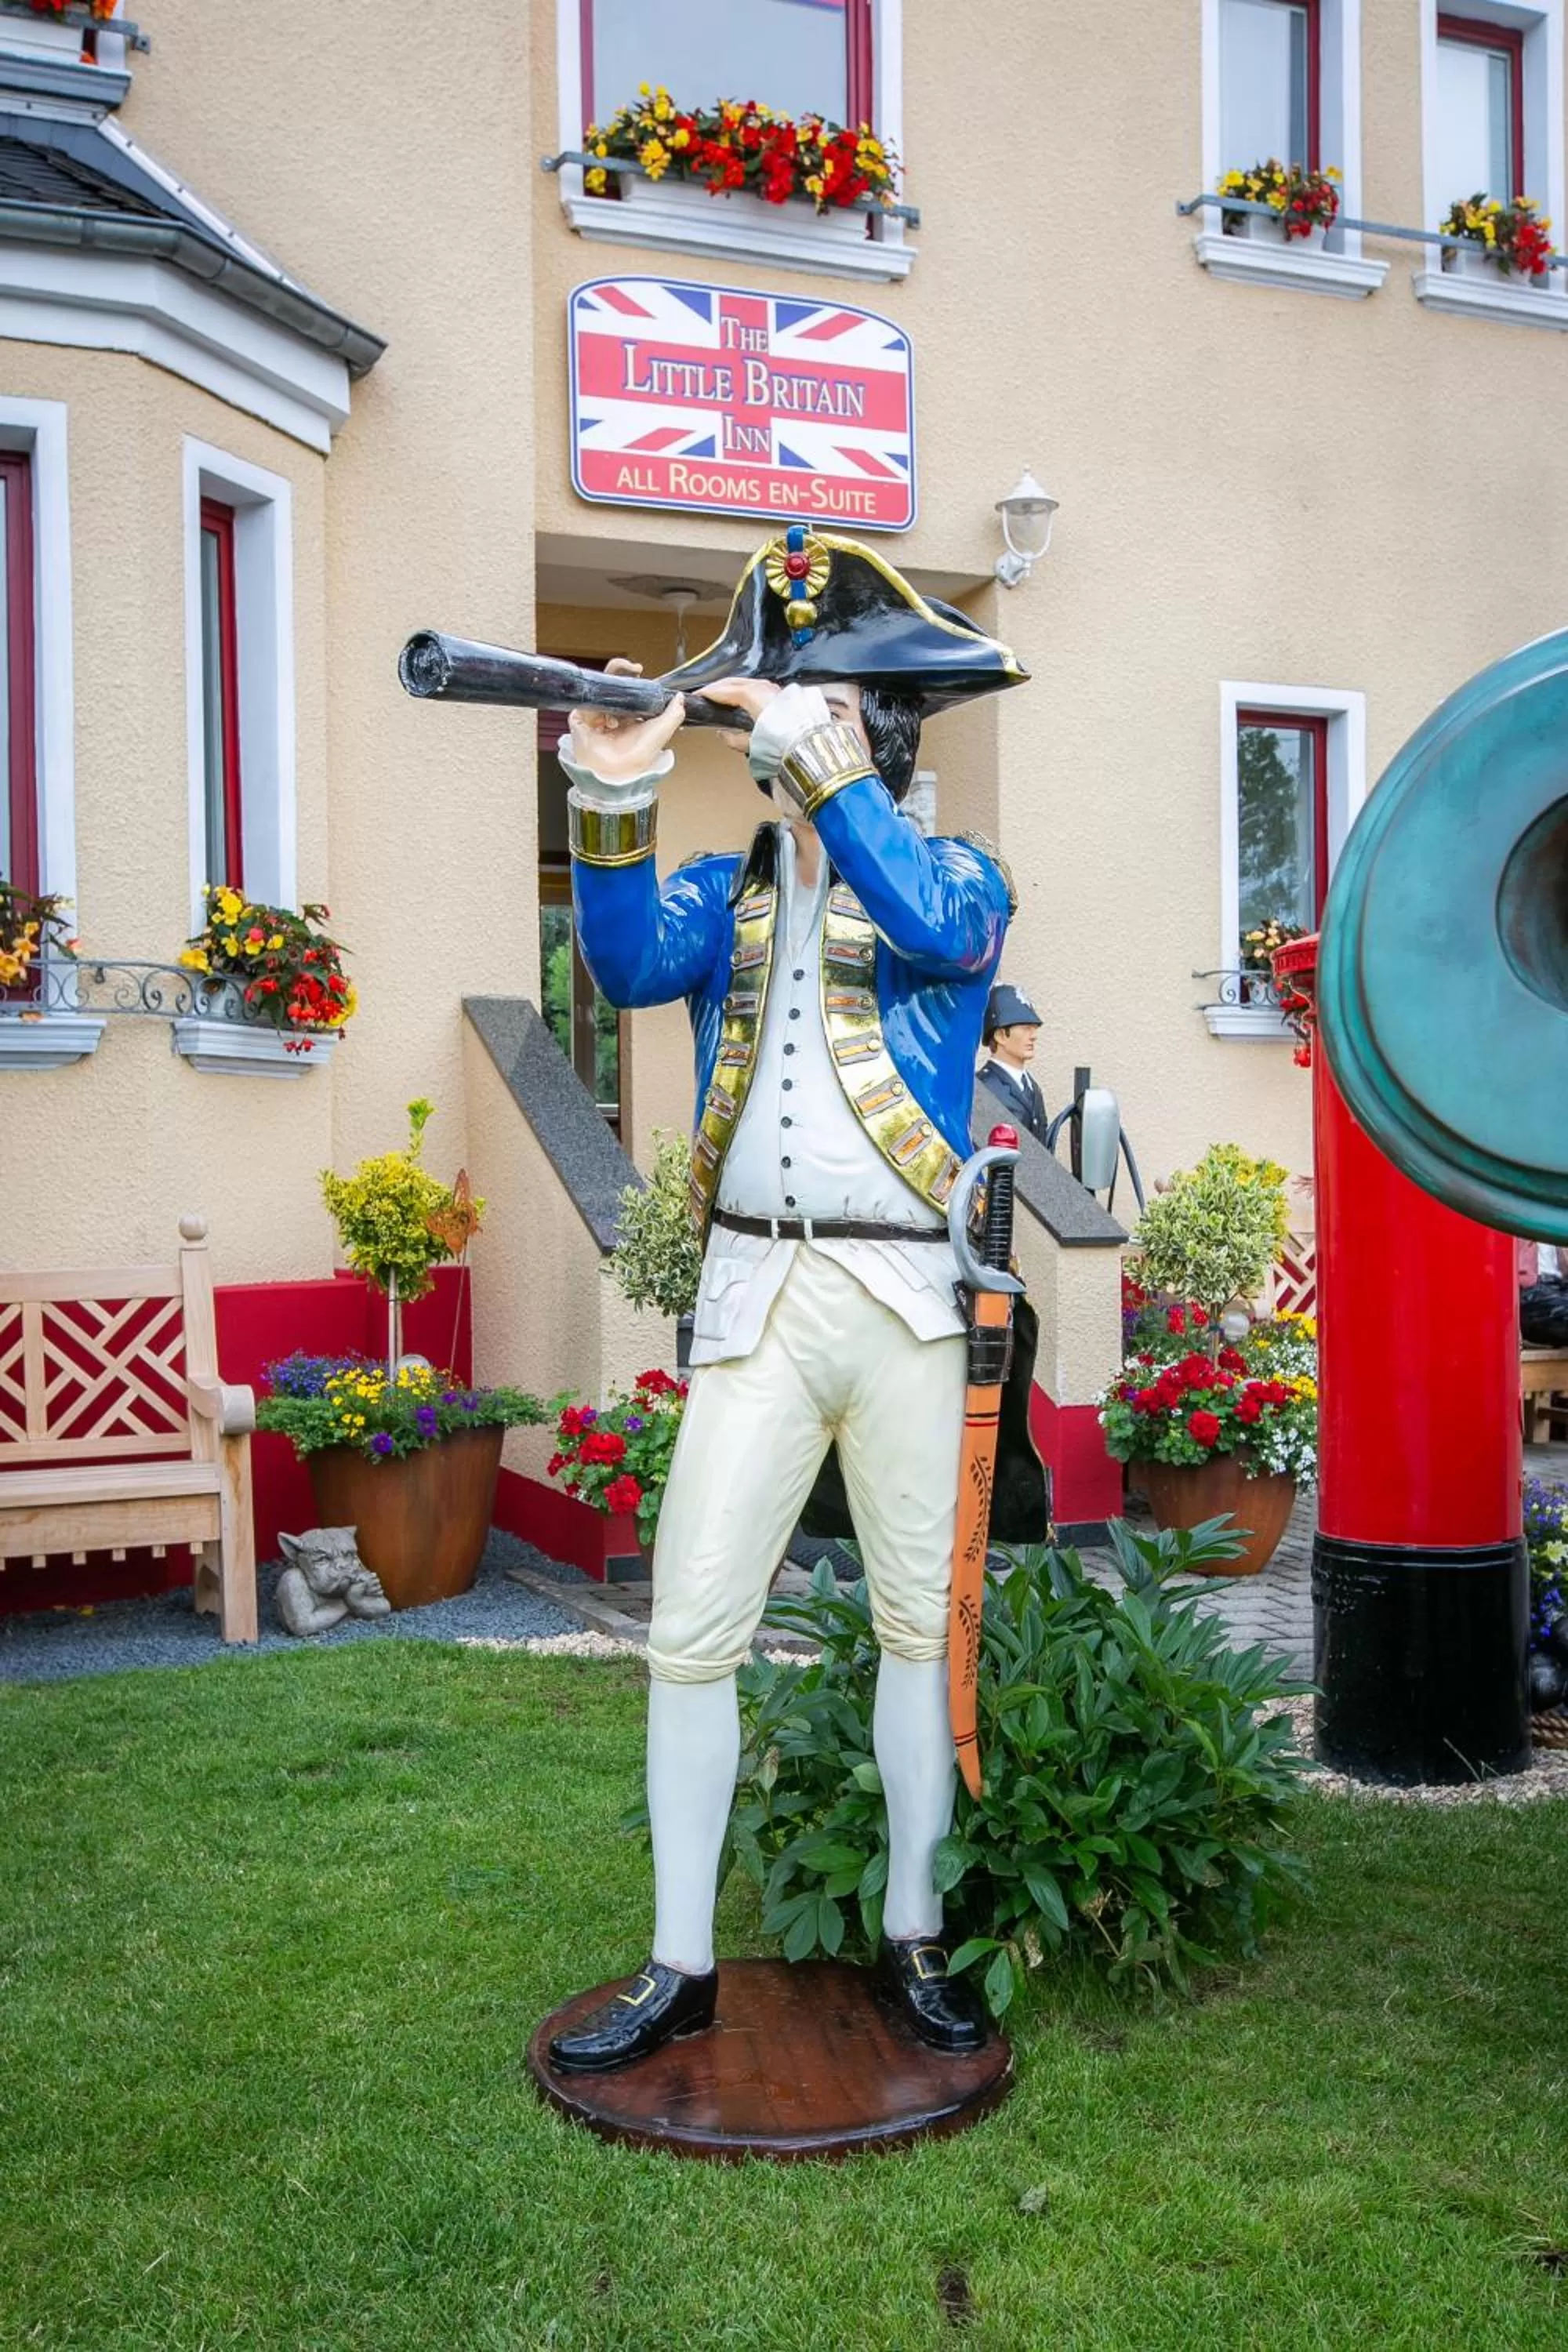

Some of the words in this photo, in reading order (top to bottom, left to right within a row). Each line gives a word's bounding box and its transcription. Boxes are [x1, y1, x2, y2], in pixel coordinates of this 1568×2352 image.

[720, 315, 768, 353] THE
[623, 343, 732, 402] LITTLE
[744, 358, 865, 417] BRITAIN
[723, 415, 771, 452] INN
[617, 465, 660, 492] ALL
[670, 464, 760, 501] ROOMS
[770, 478, 877, 514] EN-SUITE
